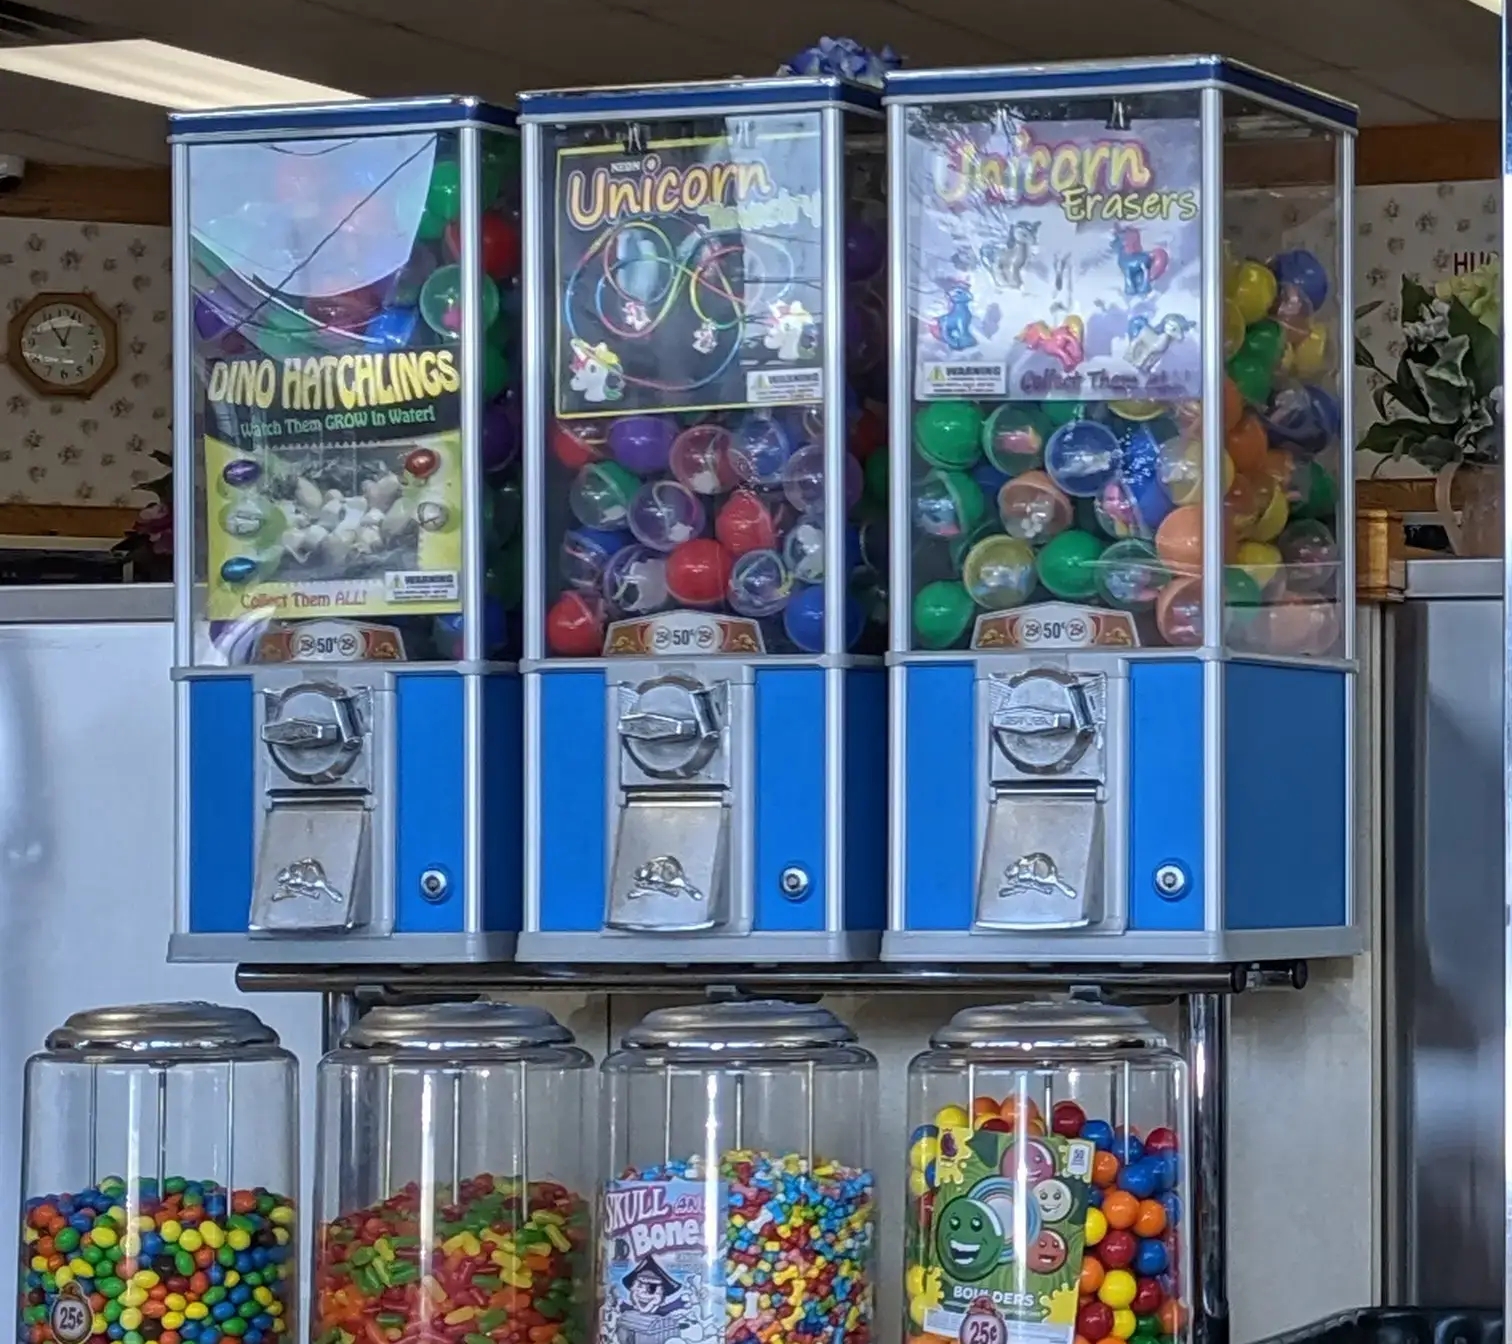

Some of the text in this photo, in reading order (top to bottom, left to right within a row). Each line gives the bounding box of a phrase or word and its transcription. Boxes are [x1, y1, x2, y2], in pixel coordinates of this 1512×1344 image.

[571, 156, 775, 227] Unicorn
[1060, 186, 1199, 221] Erasers
[208, 350, 461, 410] DINO HATCHLINGS
[945, 366, 1001, 376] WARNING
[240, 405, 437, 438] Watch Them GROW In Water!
[241, 592, 367, 609] Collect Them ALL!
[317, 636, 338, 654] 50¢
[672, 629, 694, 645] 50¢
[1043, 622, 1066, 639] 50¢
[604, 1187, 670, 1233] SKULL
[631, 1220, 705, 1256] Bone
[59, 1306, 84, 1331] 25¢
